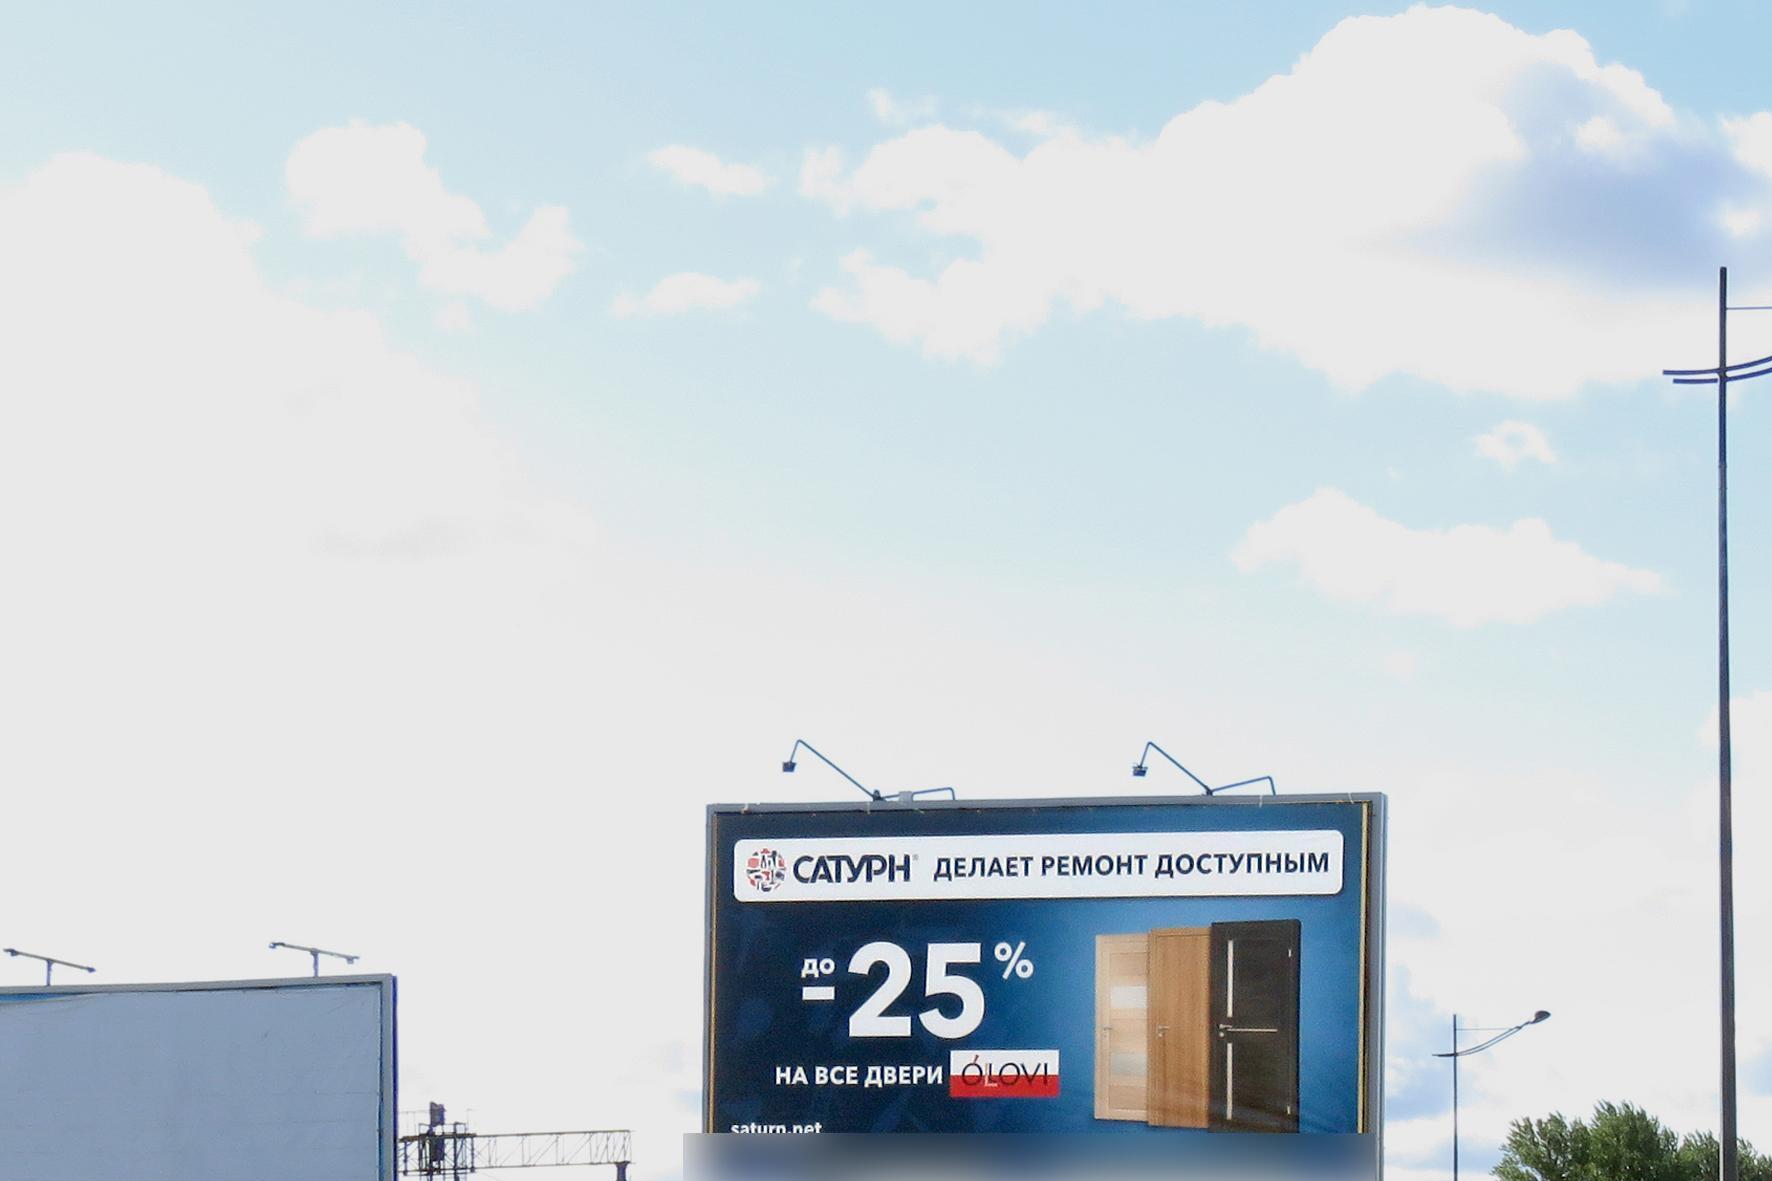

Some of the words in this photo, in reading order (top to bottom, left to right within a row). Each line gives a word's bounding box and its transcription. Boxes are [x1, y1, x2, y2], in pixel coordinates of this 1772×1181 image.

[793, 854, 911, 883] САТУРН
[933, 857, 1034, 881] ДЕЛАЕТ
[1041, 854, 1149, 876] РЕМОНТ
[1155, 852, 1329, 878] ДОСТУПНЫМ
[775, 1067, 808, 1085] НА
[815, 1066, 858, 1085] ВСЕ
[864, 1065, 943, 1088] ДВЕРИ
